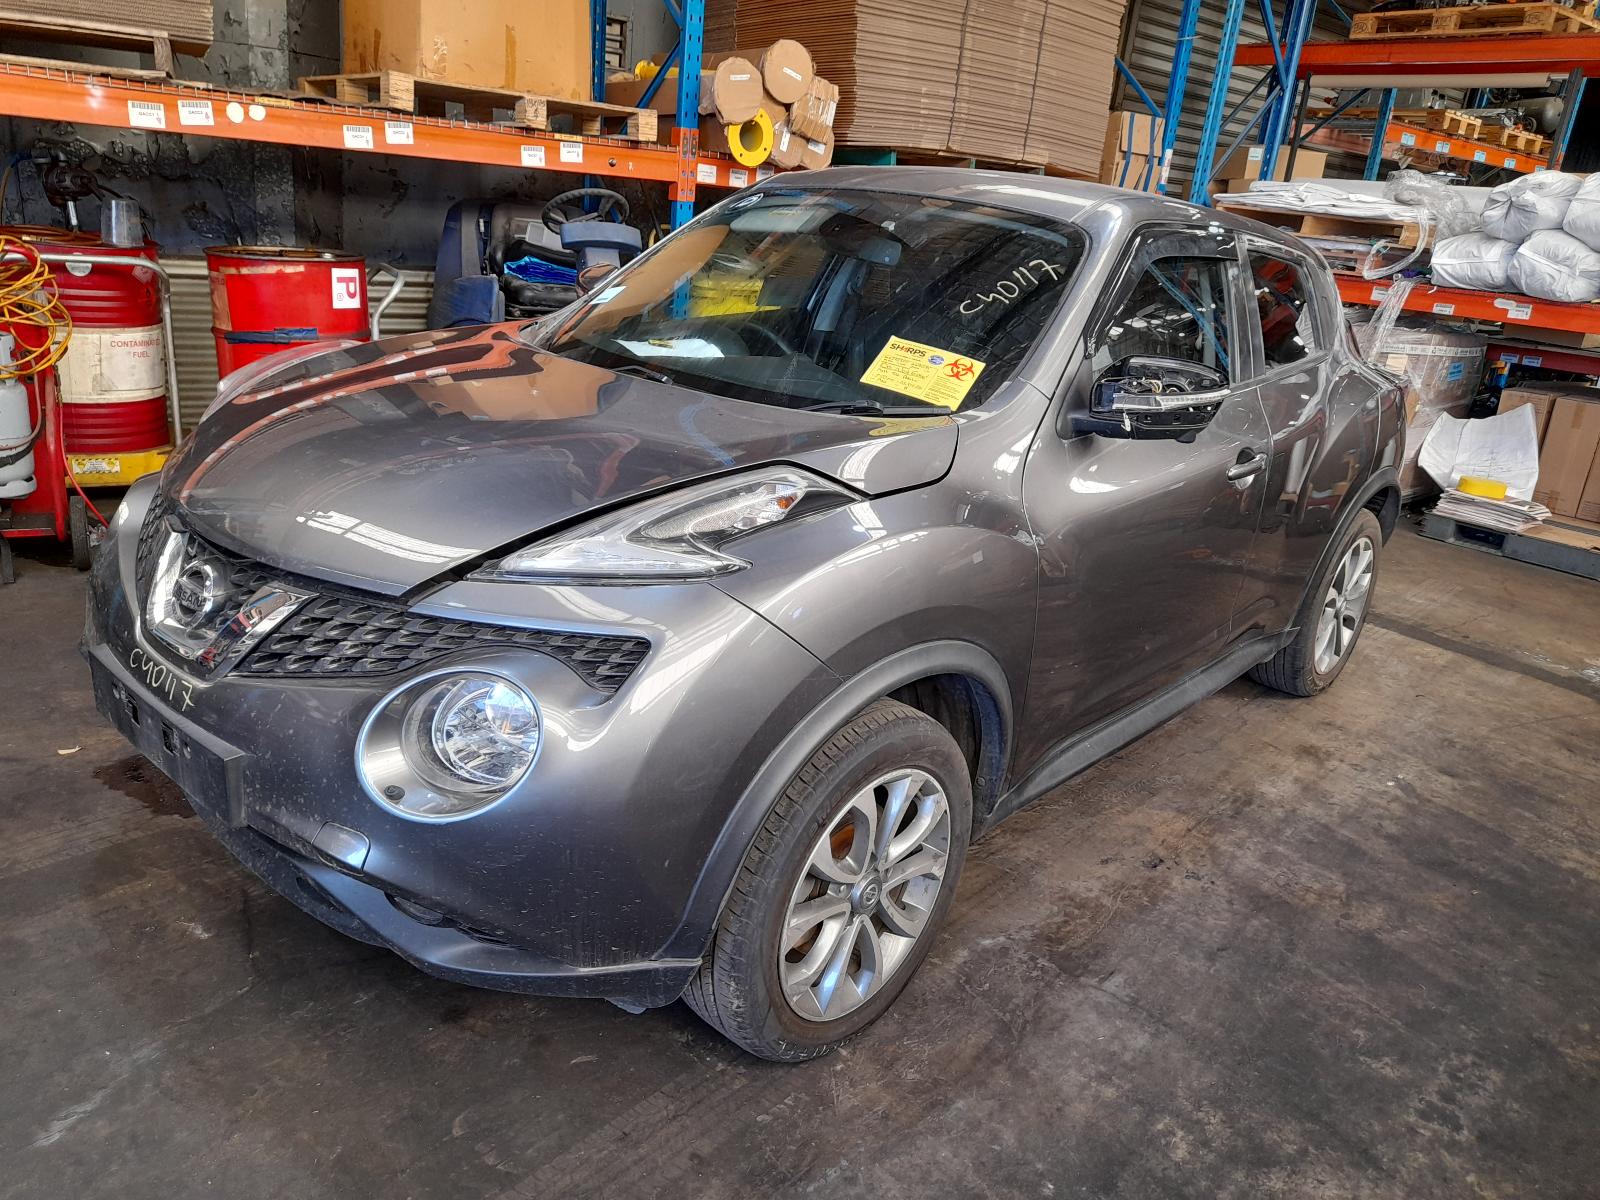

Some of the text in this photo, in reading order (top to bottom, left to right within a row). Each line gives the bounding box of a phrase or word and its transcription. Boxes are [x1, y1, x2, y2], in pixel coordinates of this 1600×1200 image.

[337, 277, 358, 299] P
[960, 259, 1061, 314] C40117
[130, 648, 196, 712] C40117
